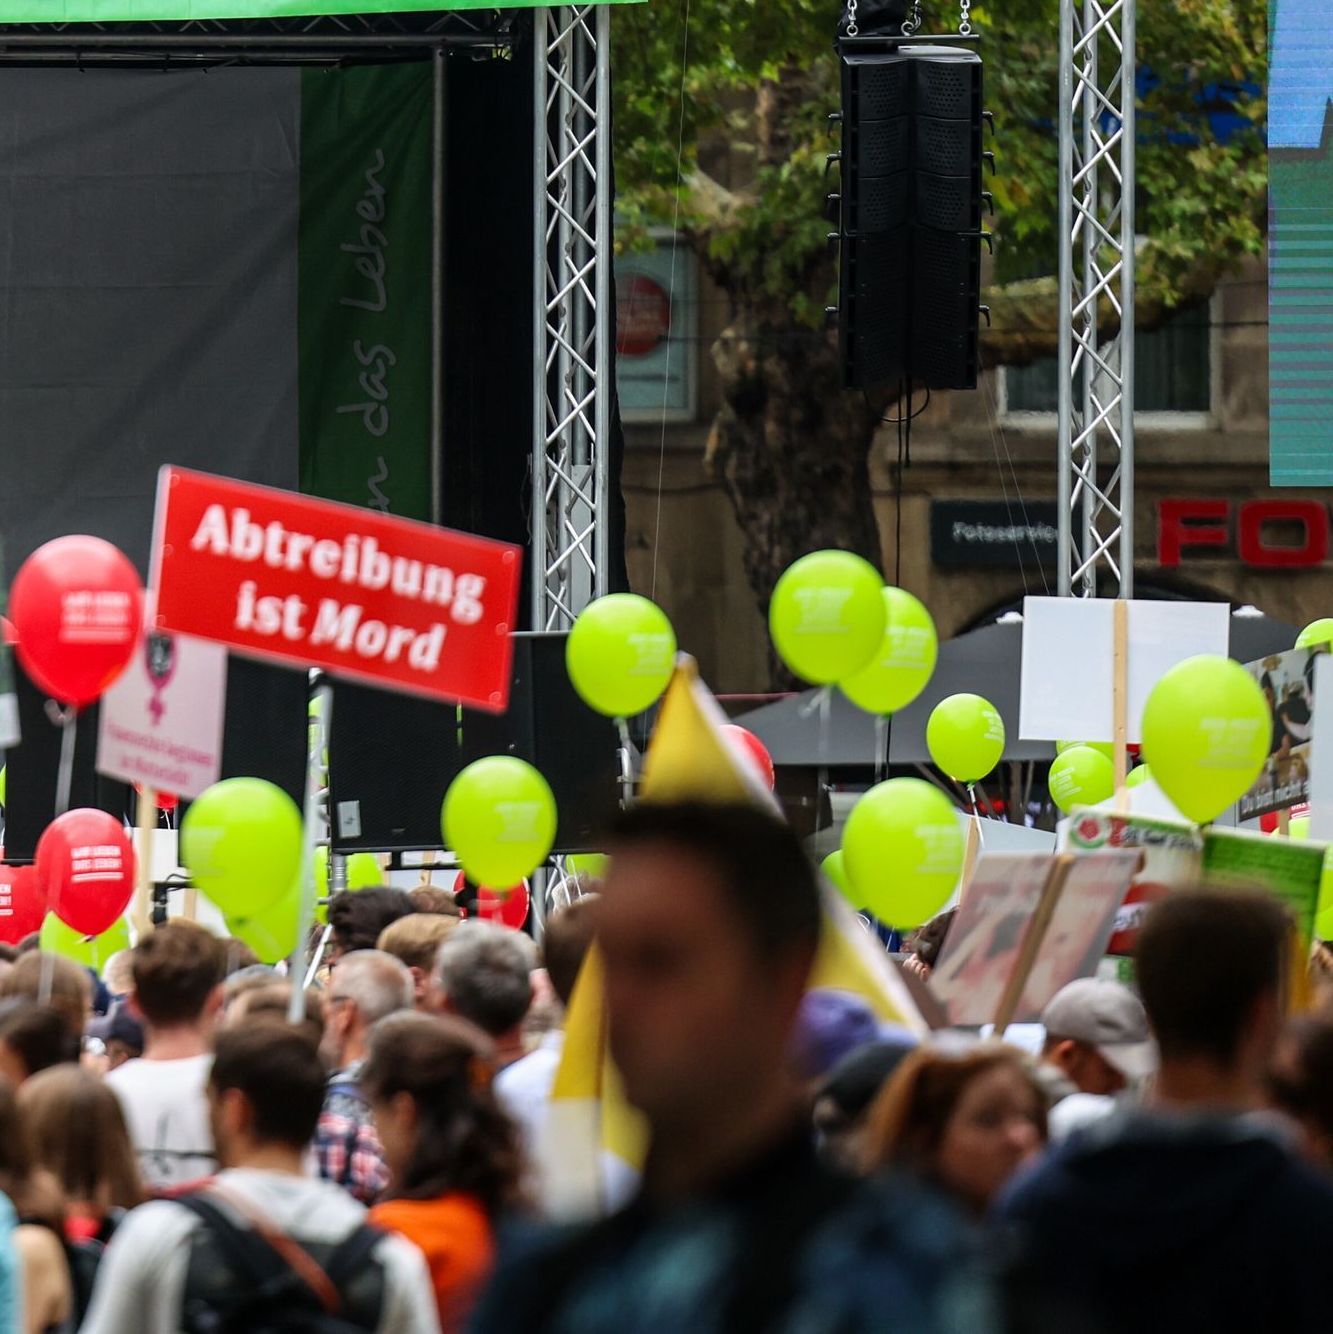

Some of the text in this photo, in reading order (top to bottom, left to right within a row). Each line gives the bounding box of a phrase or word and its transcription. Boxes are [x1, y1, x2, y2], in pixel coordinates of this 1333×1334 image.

[340, 148, 389, 313] Leben
[336, 339, 397, 437] das
[191, 504, 487, 625] Abtreibung
[235, 580, 447, 673] ist Mord
